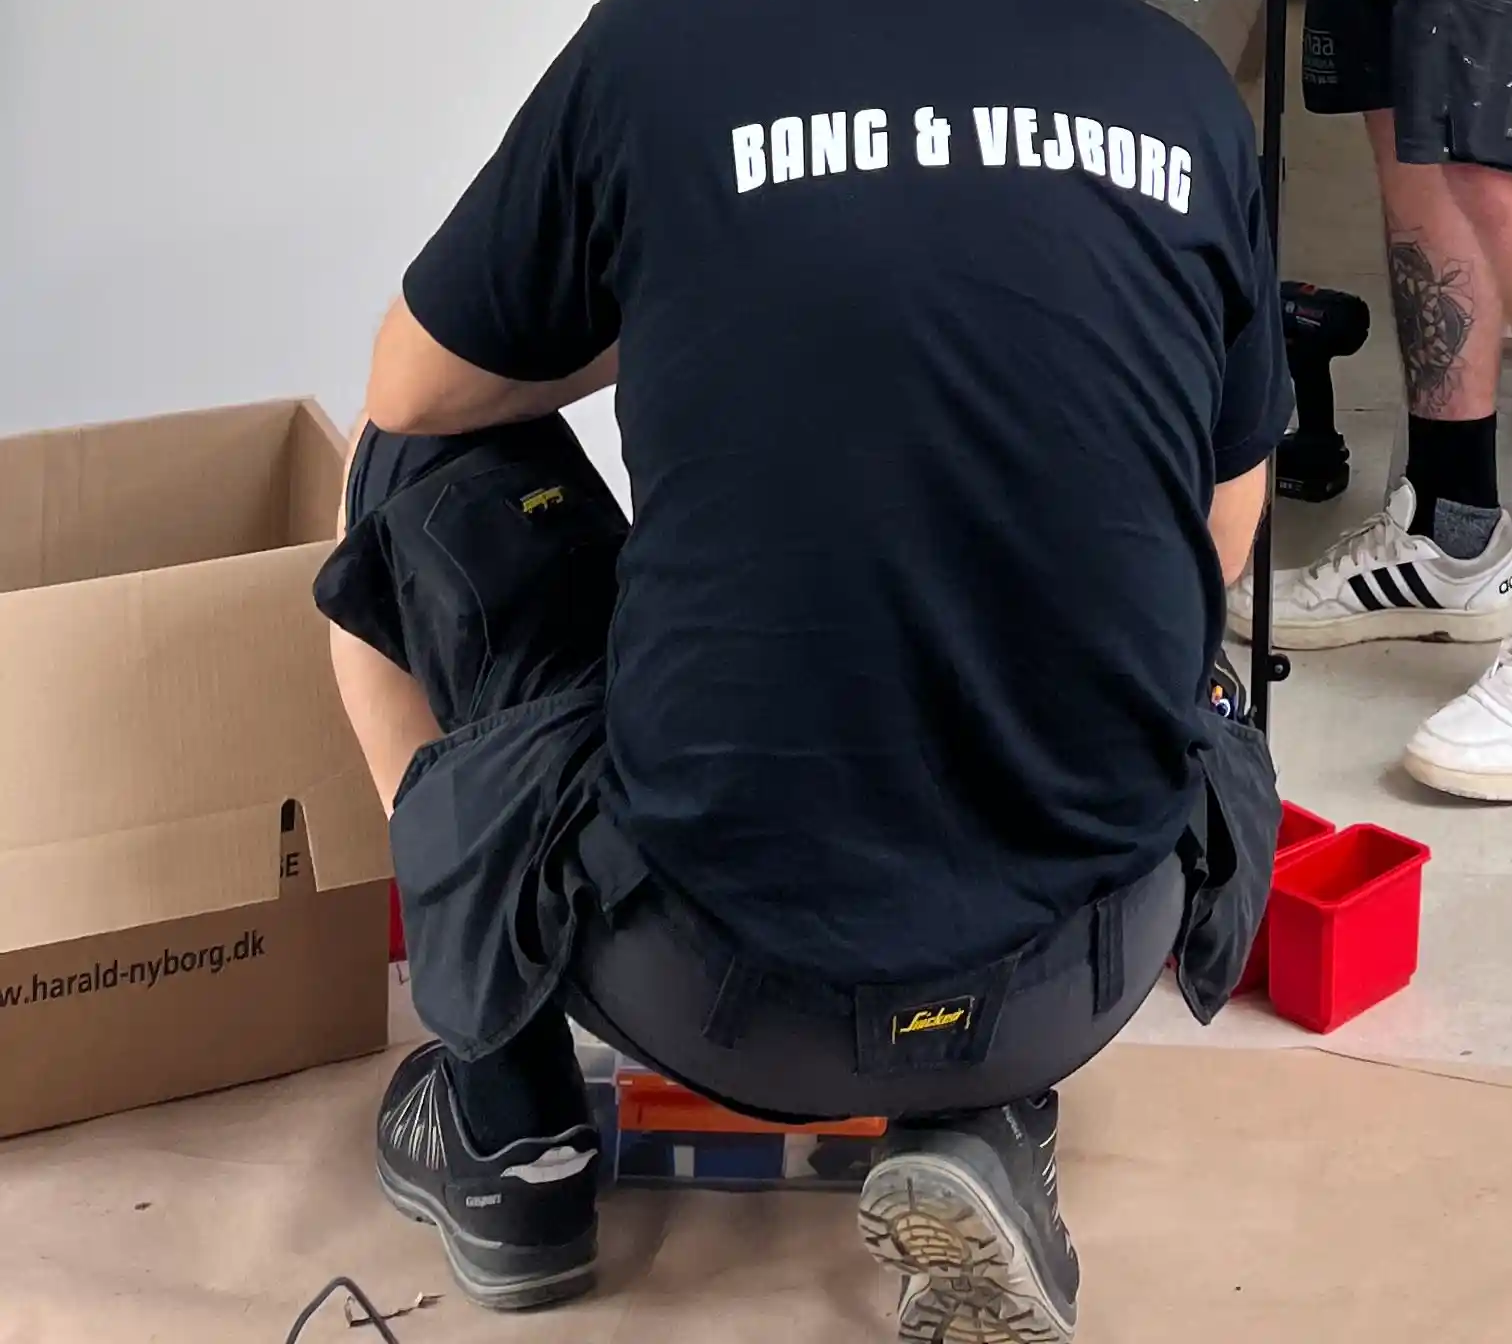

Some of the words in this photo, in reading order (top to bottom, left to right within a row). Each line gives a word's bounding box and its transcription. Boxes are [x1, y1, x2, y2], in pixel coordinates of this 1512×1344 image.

[731, 108, 889, 194] BANG
[913, 105, 951, 167] &
[972, 106, 1192, 215] VEJBORG
[279, 852, 300, 879] E
